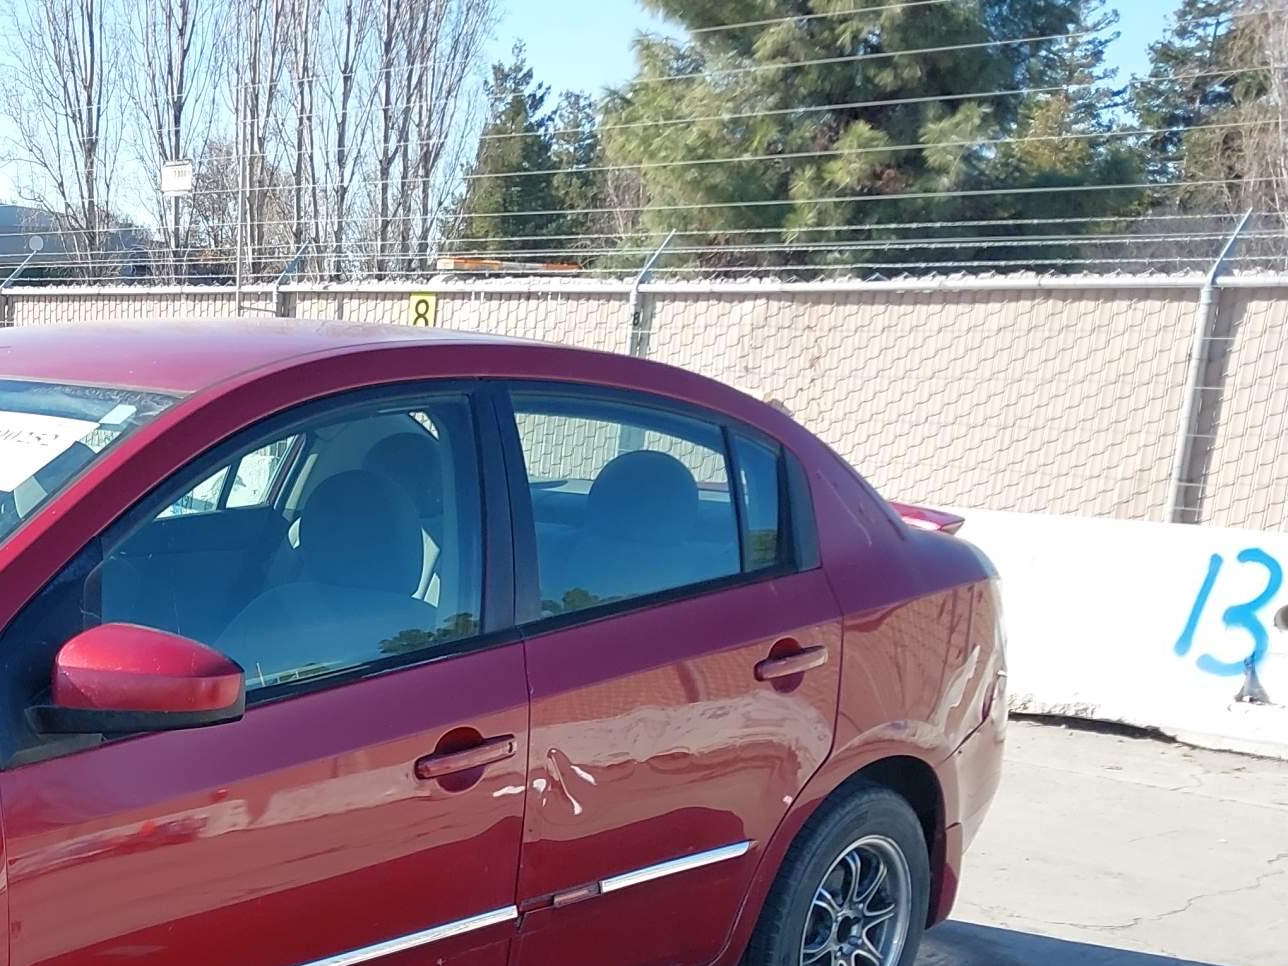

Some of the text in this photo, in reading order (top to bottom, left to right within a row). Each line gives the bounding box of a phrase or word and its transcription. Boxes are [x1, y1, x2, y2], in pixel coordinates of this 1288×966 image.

[415, 299, 430, 327] 8
[633, 311, 641, 327] 8
[1173, 547, 1283, 677] 13
